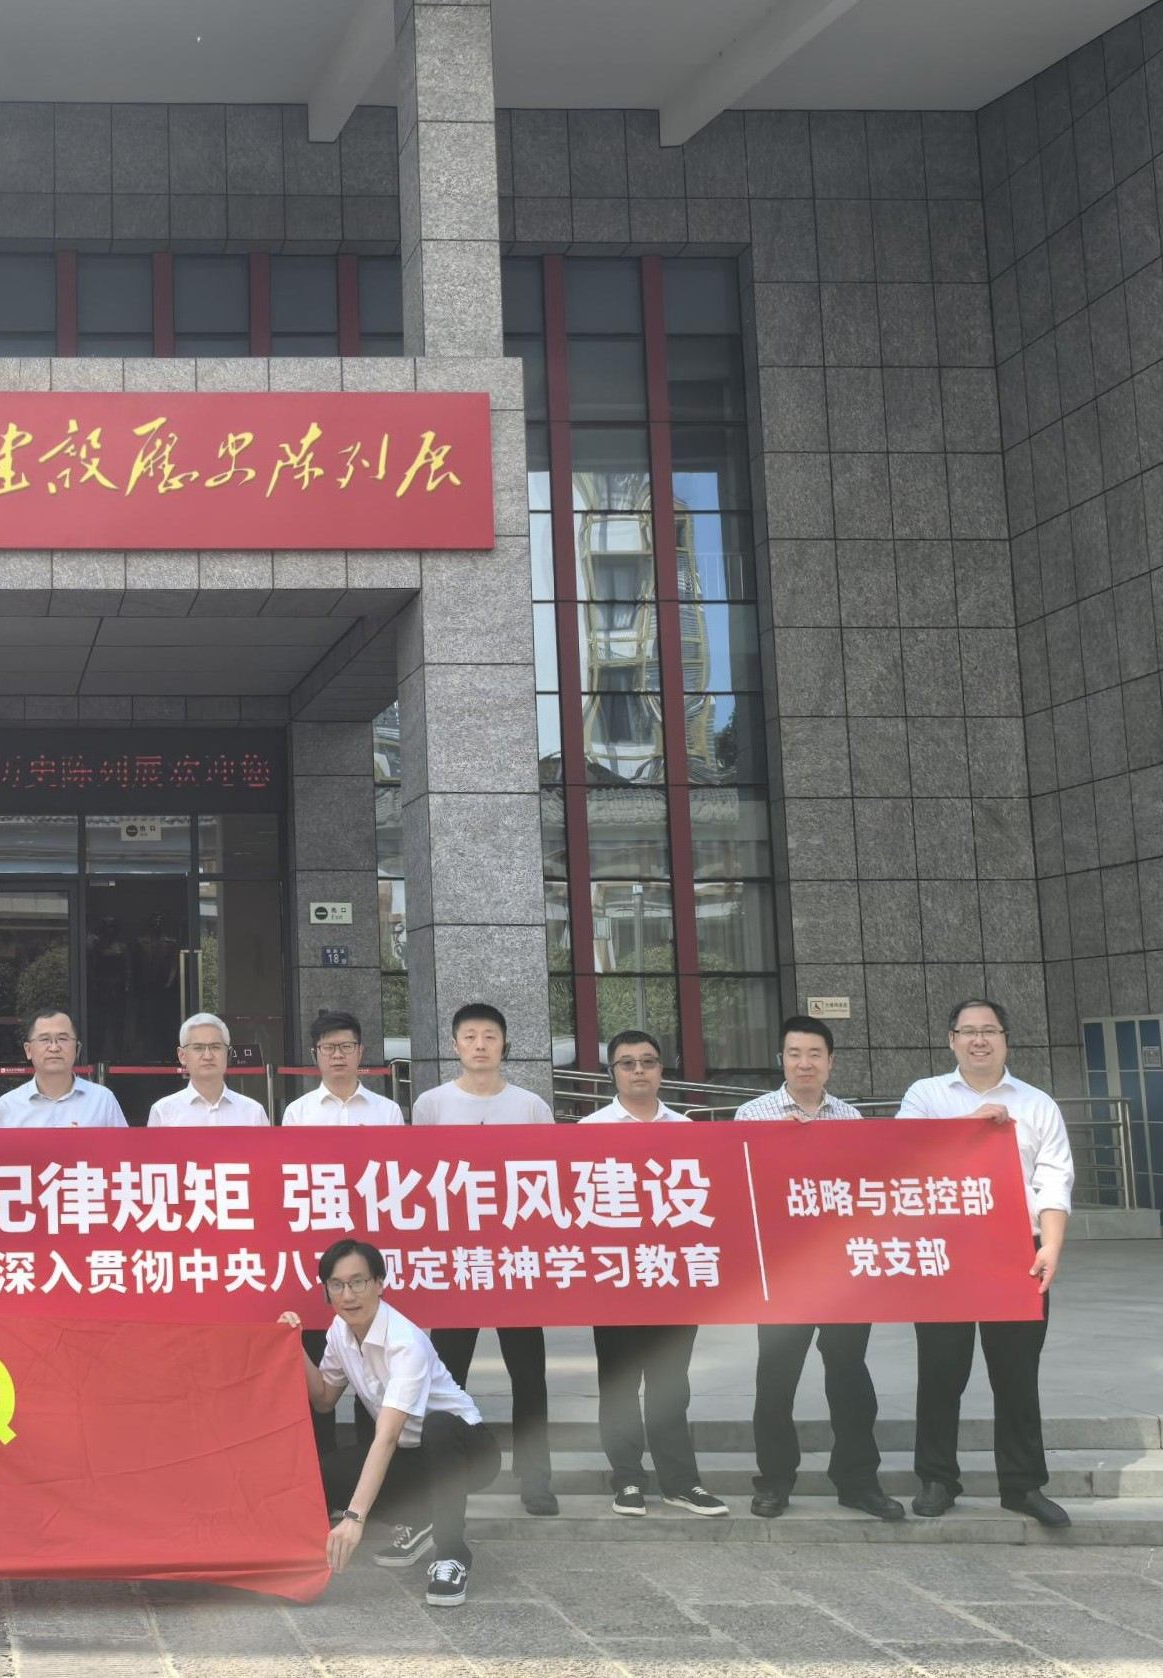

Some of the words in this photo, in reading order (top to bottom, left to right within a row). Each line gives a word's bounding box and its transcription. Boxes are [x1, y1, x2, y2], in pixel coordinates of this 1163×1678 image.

[281, 1157, 715, 1233] 强化作风建设
[787, 1175, 993, 1219] 战略与运控部
[845, 1236, 950, 1278] 党支部
